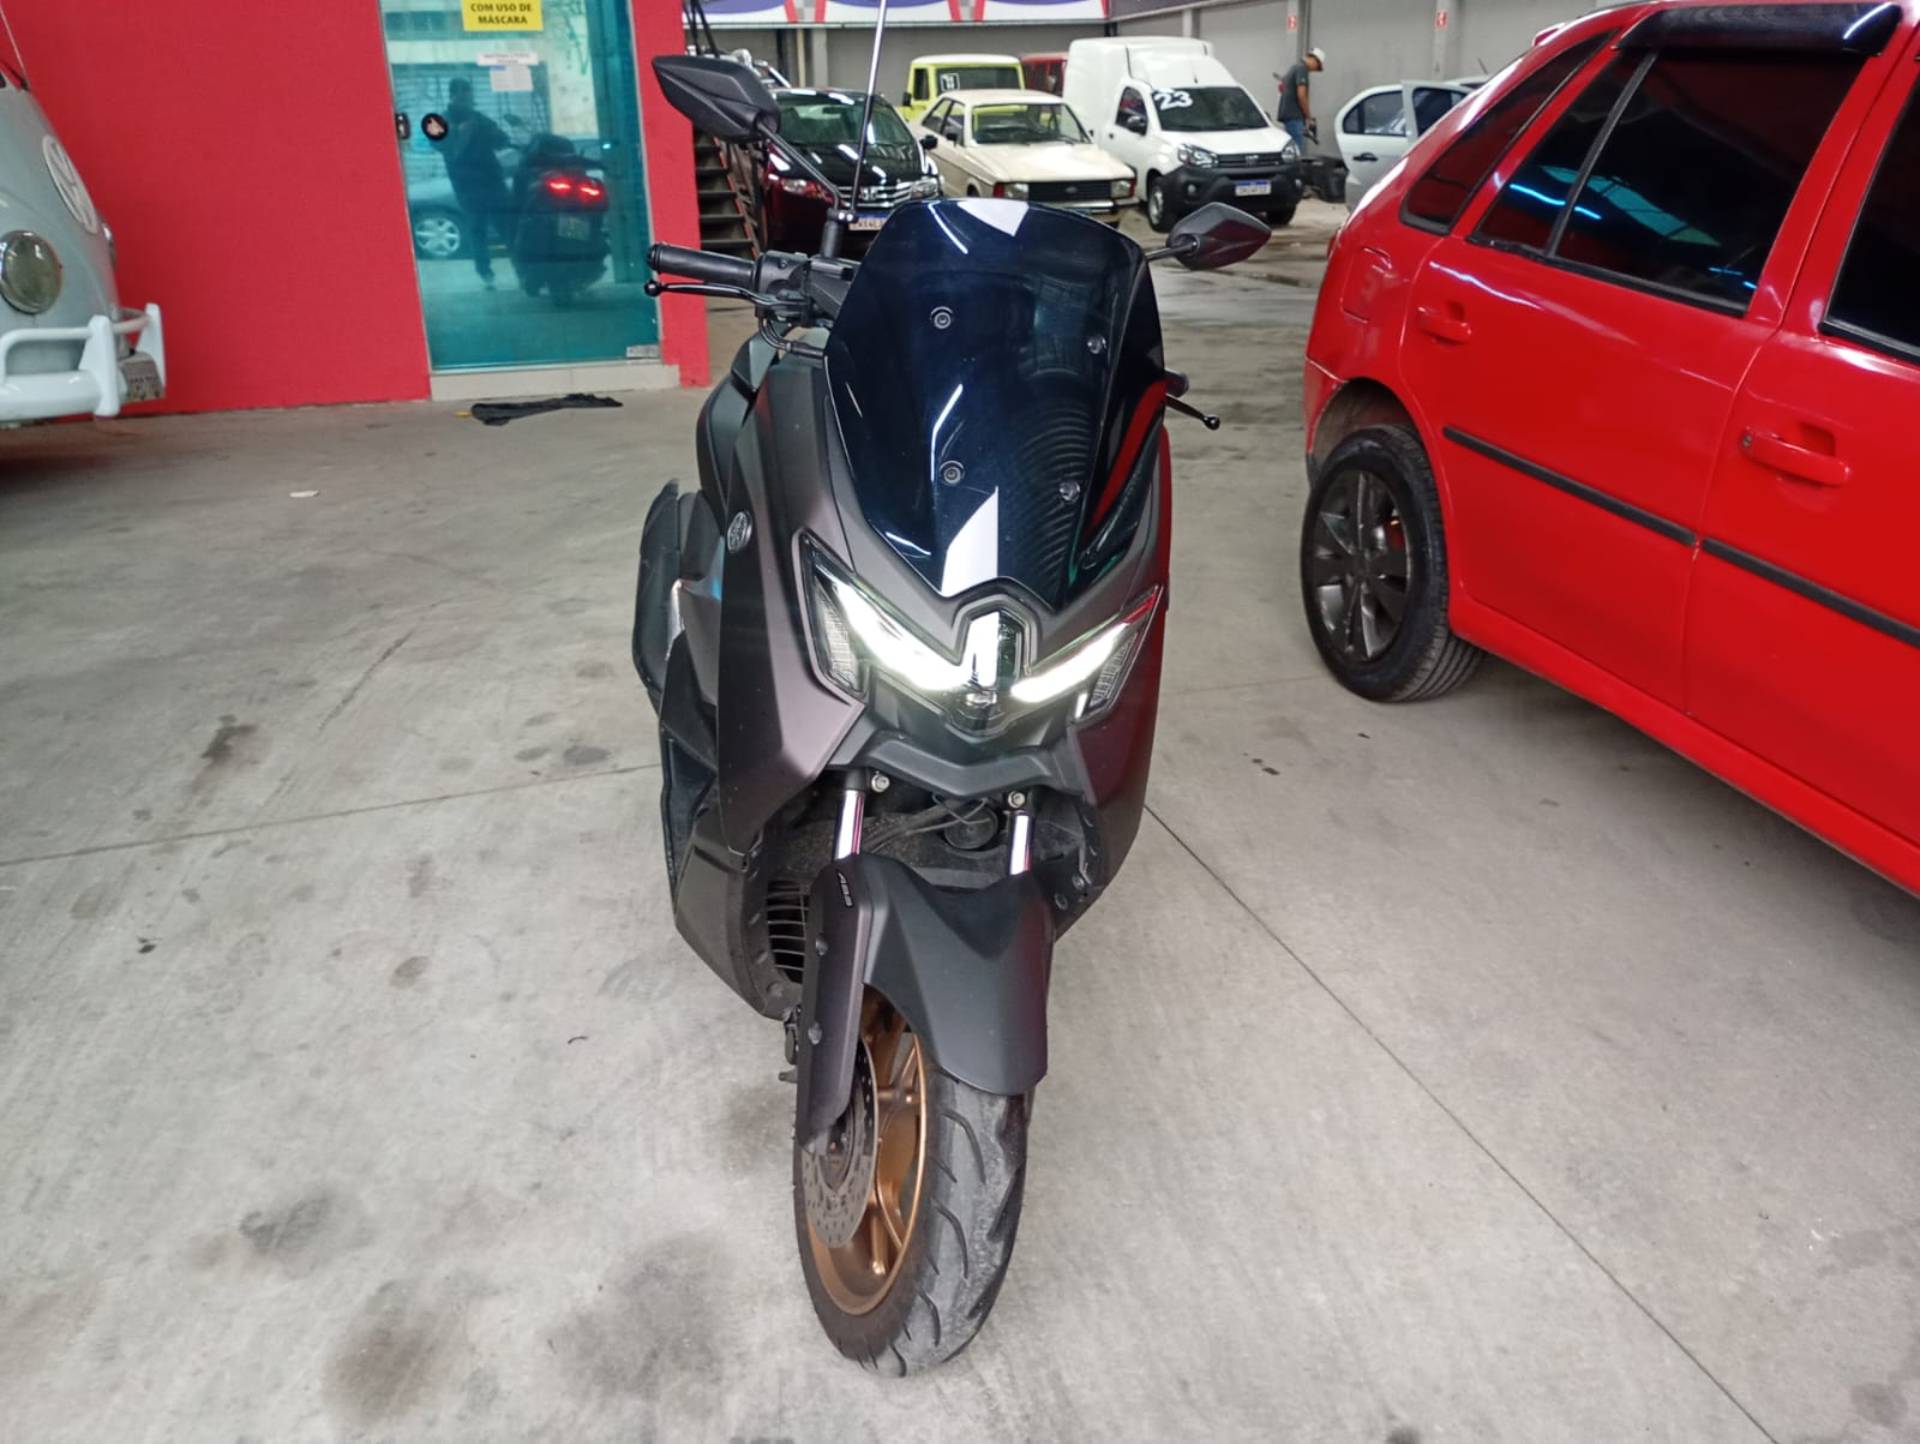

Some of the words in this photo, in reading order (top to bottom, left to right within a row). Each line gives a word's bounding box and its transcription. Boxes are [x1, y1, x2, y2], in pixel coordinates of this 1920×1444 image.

[470, 3, 494, 12] COM
[495, 3, 517, 12] USO
[518, 3, 532, 12] DE
[478, 14, 528, 24] MÁSCARA
[1154, 90, 1193, 110] 23
